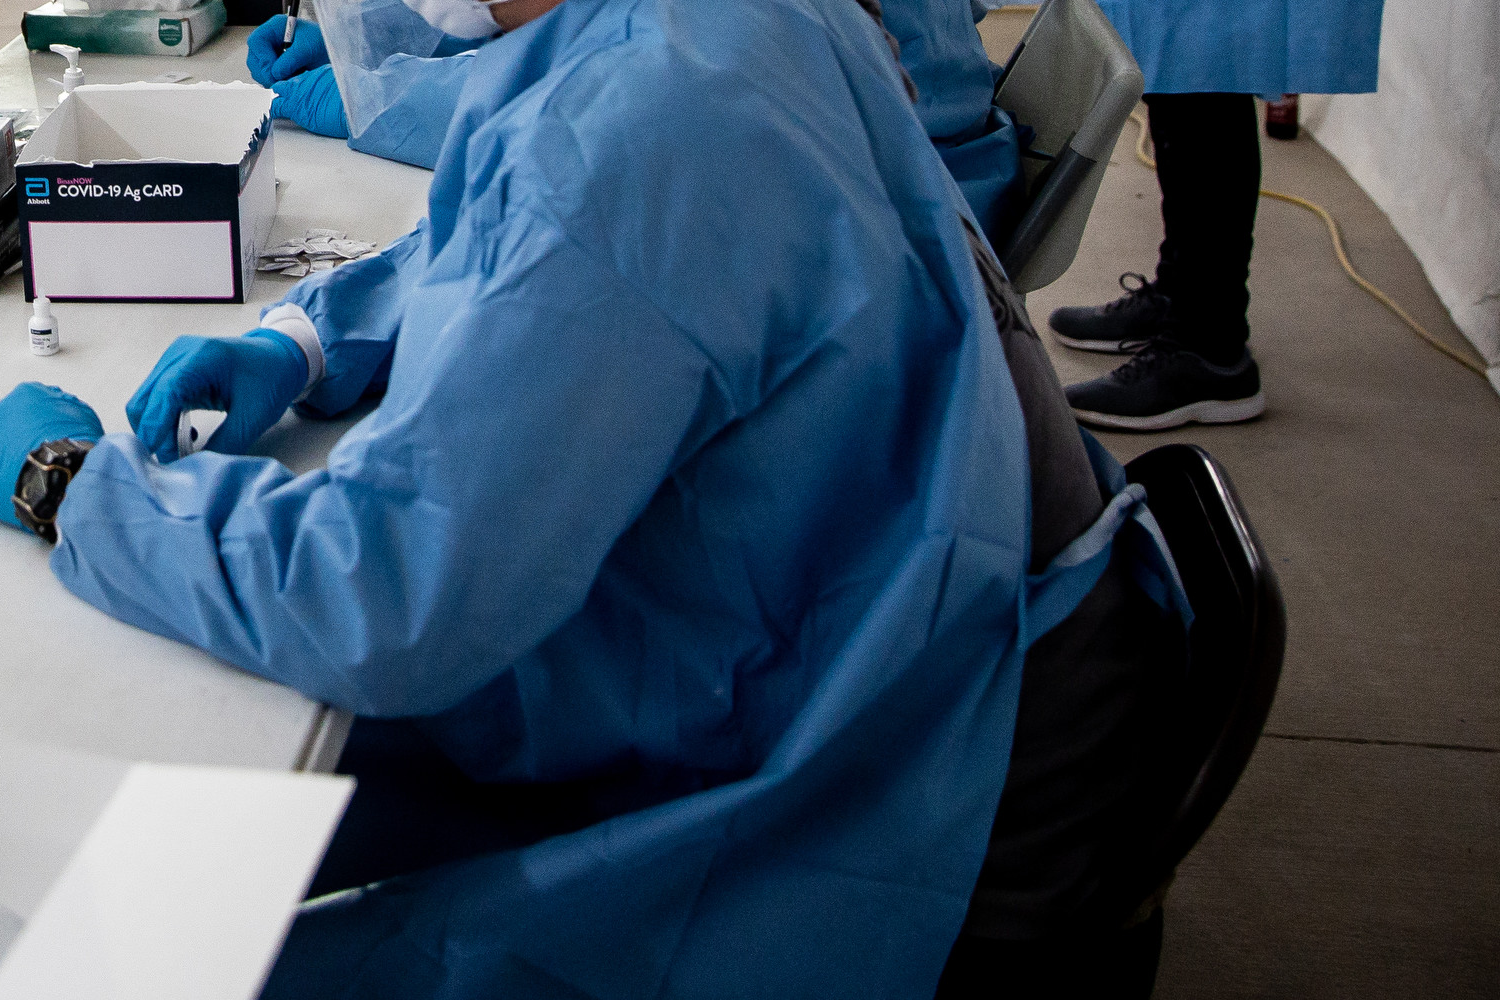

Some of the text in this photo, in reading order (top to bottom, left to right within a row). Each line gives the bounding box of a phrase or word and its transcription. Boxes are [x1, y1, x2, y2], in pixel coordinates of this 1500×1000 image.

[56, 177, 93, 185] BinaxNOW
[57, 184, 183, 202] COVID-19 Ag CARD
